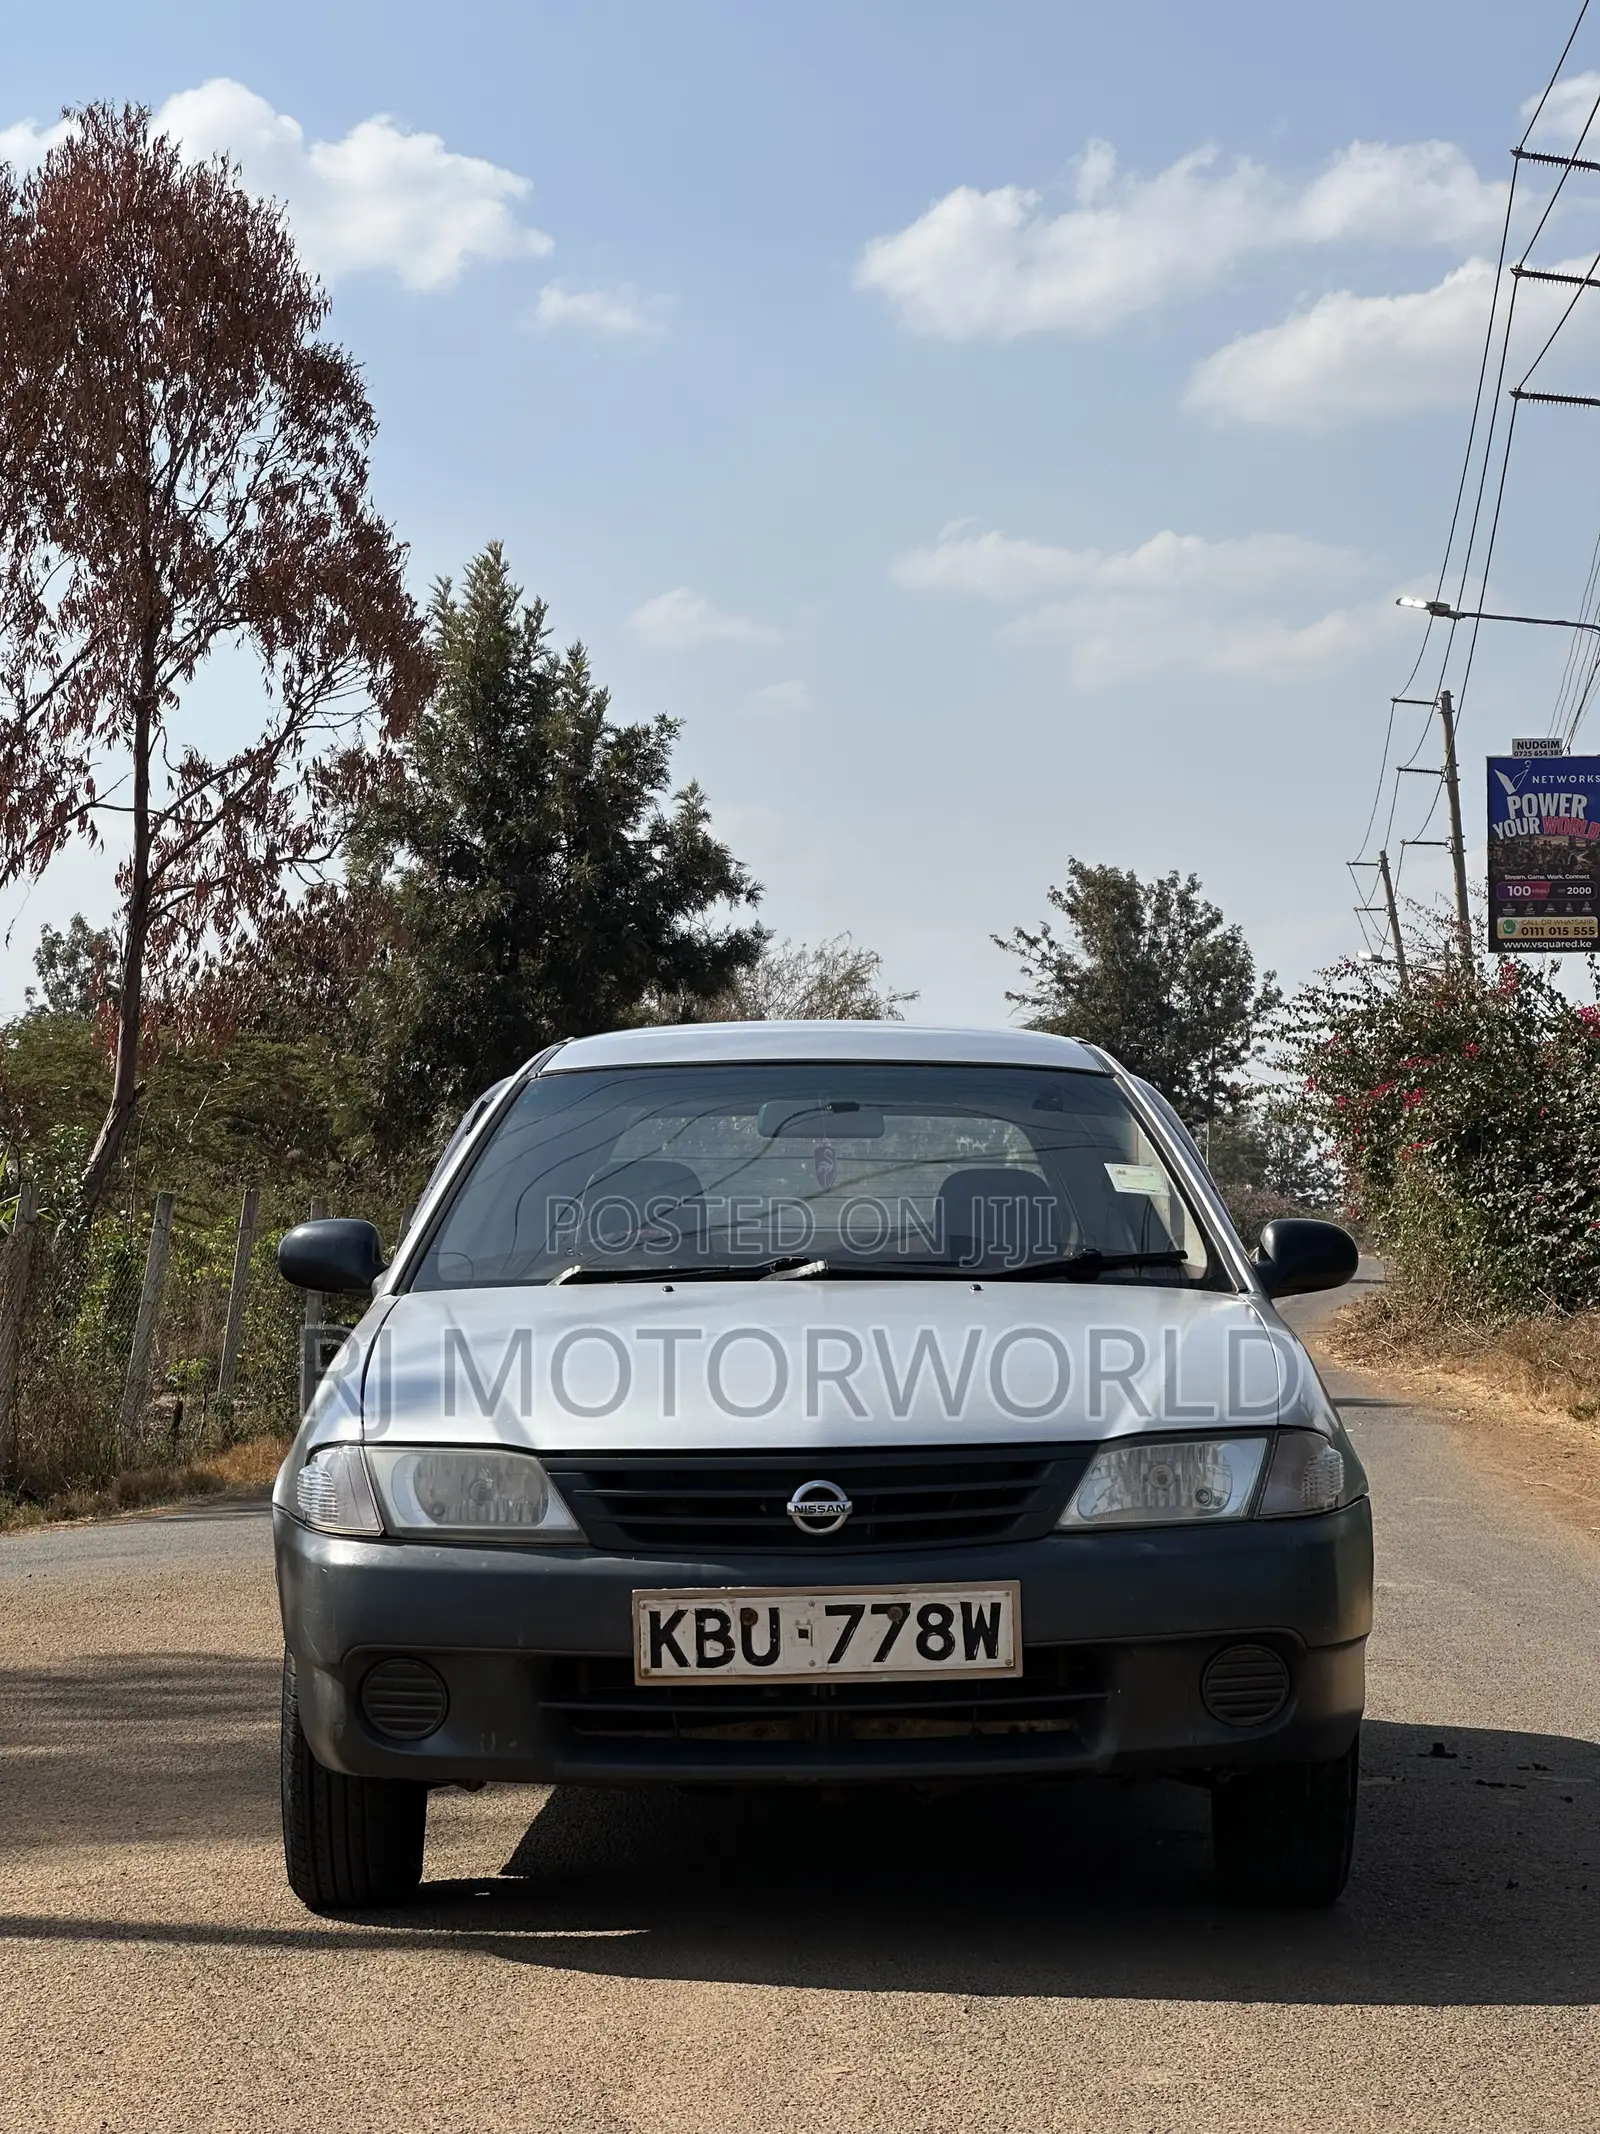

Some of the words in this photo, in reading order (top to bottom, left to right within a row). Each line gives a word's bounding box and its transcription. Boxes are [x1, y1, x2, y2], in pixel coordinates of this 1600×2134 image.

[1517, 740, 1560, 750] NUDGIM
[1533, 749, 1548, 757] 654
[1532, 775, 1600, 784] NETWORKS
[1506, 793, 1588, 820] POWER
[1492, 817, 1541, 840] YOUR
[1542, 815, 1600, 840] WORLD
[1507, 885, 1531, 897] 100
[1566, 886, 1592, 895] 2000
[1521, 927, 1545, 936] 0111
[1549, 927, 1569, 936] 015
[1573, 927, 1595, 936] 555
[1503, 939, 1593, 950] www.vsquared.ke
[794, 1504, 846, 1514] NISSAN
[648, 1606, 781, 1669] KBU
[825, 1601, 1002, 1664] 778W
